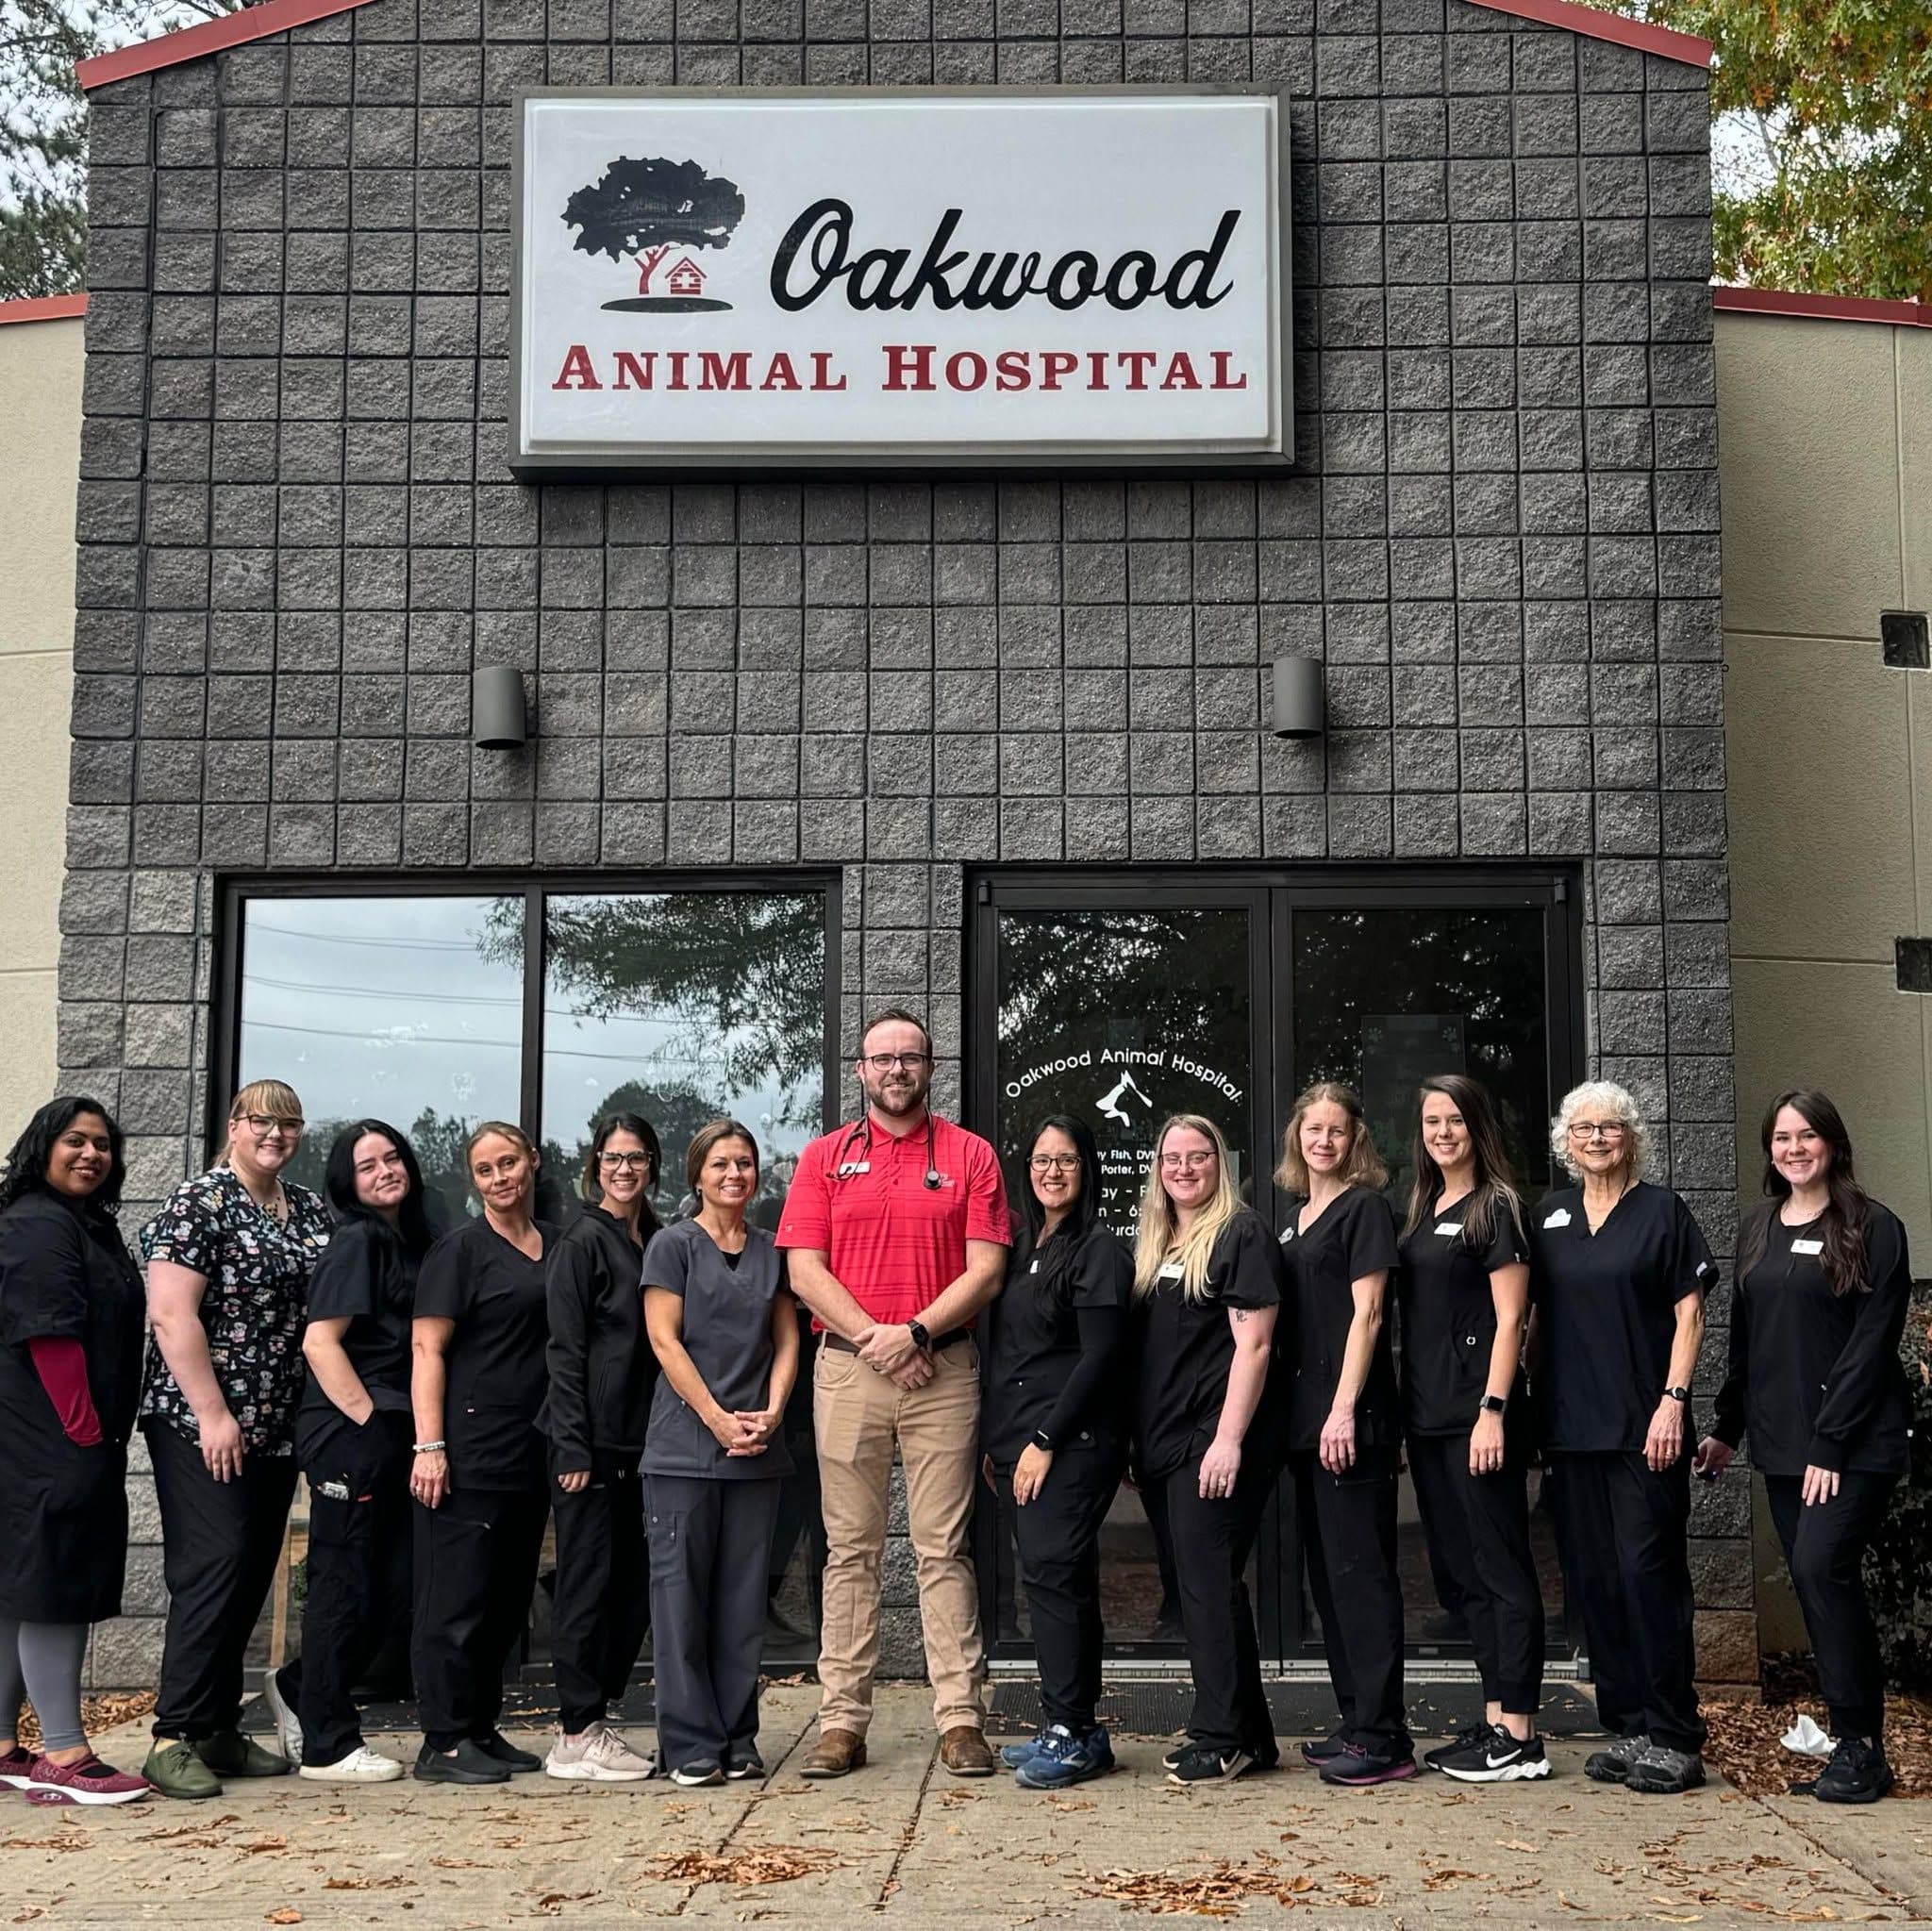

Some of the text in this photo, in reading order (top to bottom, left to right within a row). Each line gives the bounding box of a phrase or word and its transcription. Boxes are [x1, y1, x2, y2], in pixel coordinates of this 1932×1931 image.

[769, 196, 1242, 312] Oakwood
[551, 343, 1248, 392] ANIMAL HOSPITAL
[1006, 1048, 1243, 1104] Oakwood Animal Hospital
[1101, 1164, 1135, 1175] Porter,
